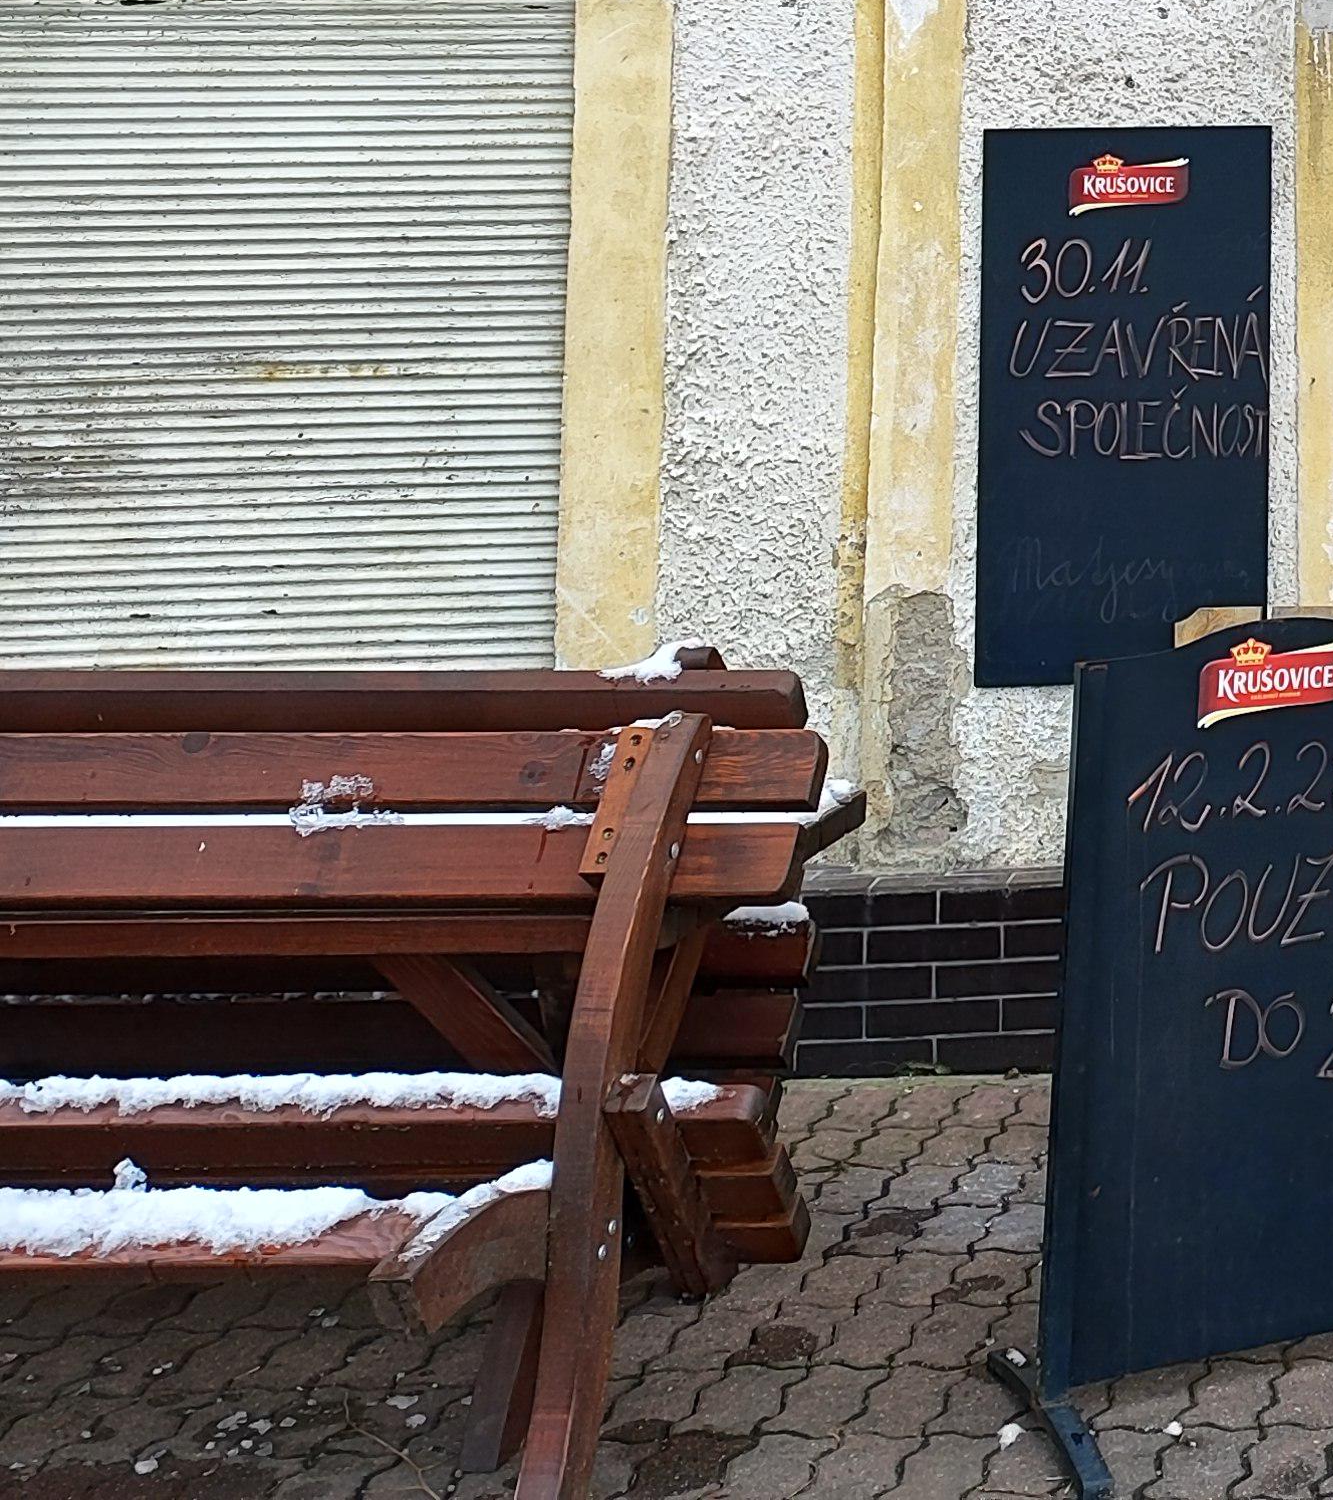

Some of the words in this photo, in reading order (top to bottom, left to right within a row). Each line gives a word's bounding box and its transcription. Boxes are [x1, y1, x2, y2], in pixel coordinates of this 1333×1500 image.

[1082, 173, 1175, 199] KRUŠOVICE
[1009, 285, 1269, 389] UZAVŘENÁ
[1019, 385, 1268, 460] SPOLEČNOST
[1205, 989, 1305, 1069] DO
